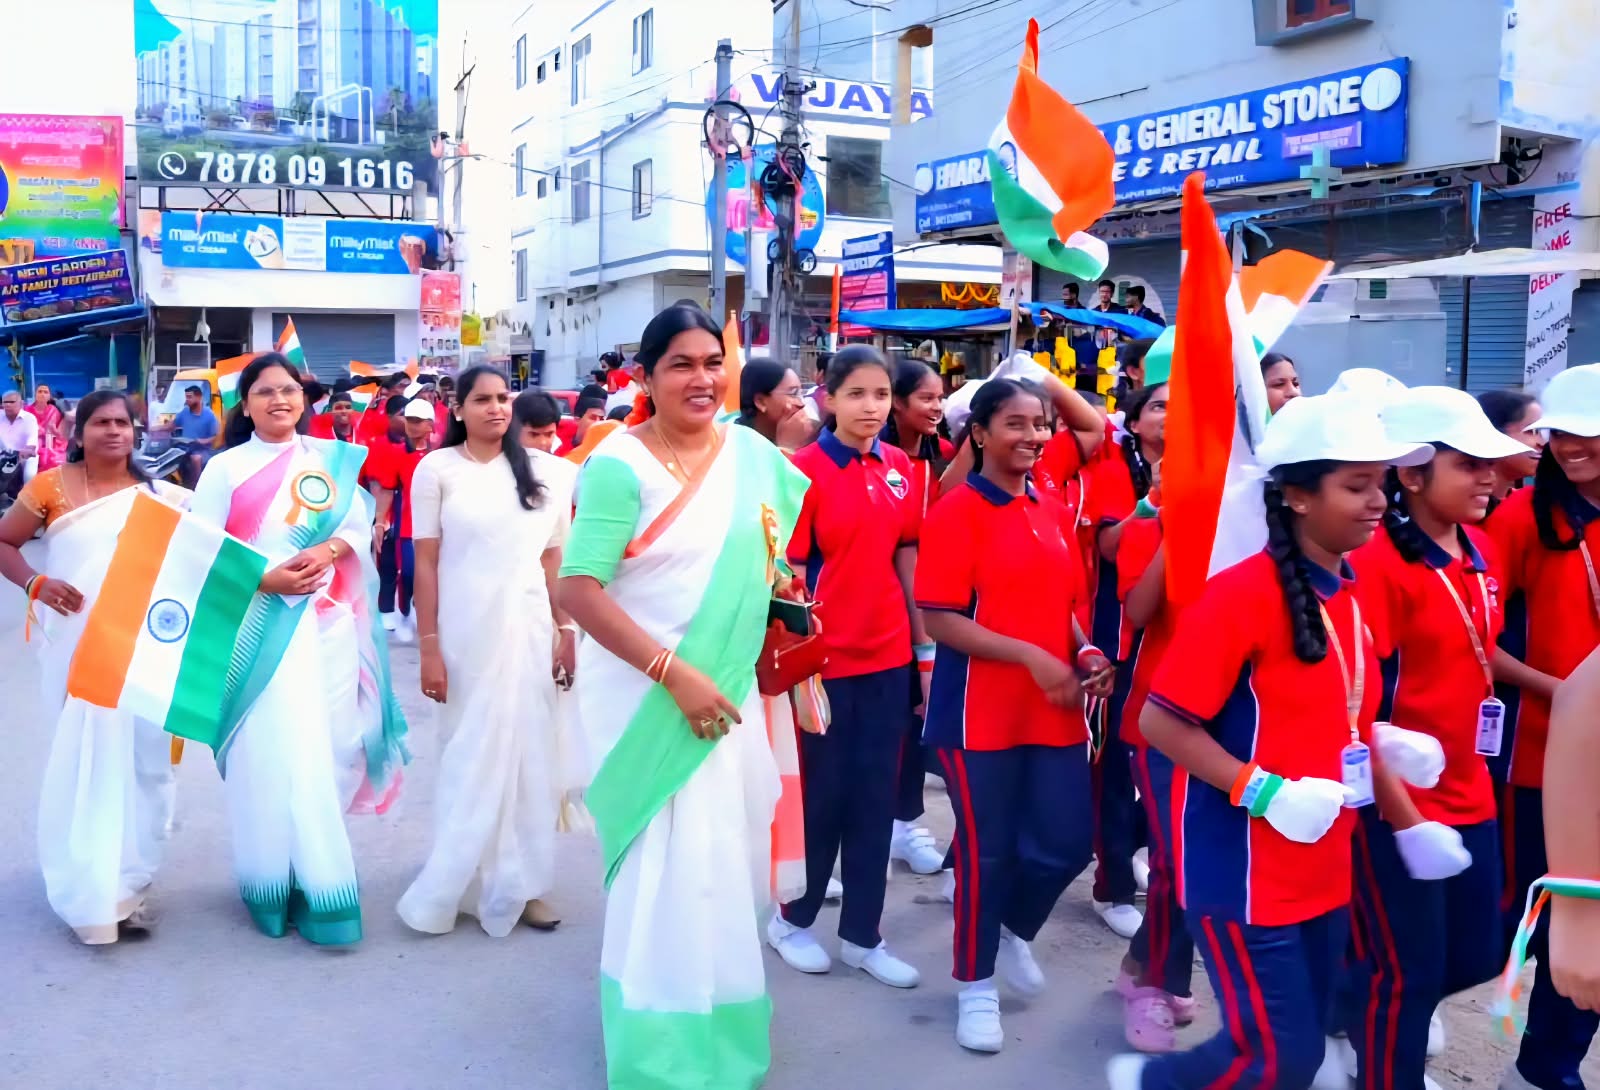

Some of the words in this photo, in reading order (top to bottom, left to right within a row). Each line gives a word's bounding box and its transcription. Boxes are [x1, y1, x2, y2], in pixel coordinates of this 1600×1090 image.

[751, 73, 933, 117] VJAYA
[1114, 124, 1133, 155] &
[1137, 99, 1257, 150] GENERAL
[1262, 75, 1362, 129] STORE
[195, 152, 277, 184] 7878
[288, 155, 326, 186] 09
[338, 157, 414, 189] 1616
[1132, 158, 1153, 177] &
[1159, 138, 1263, 174] RETAIL
[1535, 202, 1572, 233] FREE
[1, 284, 19, 296] A/C
[21, 279, 59, 293] FAMILY
[61, 268, 125, 286] RESTAURANT
[17, 266, 48, 278] NEW
[51, 257, 107, 274] GARDEN
